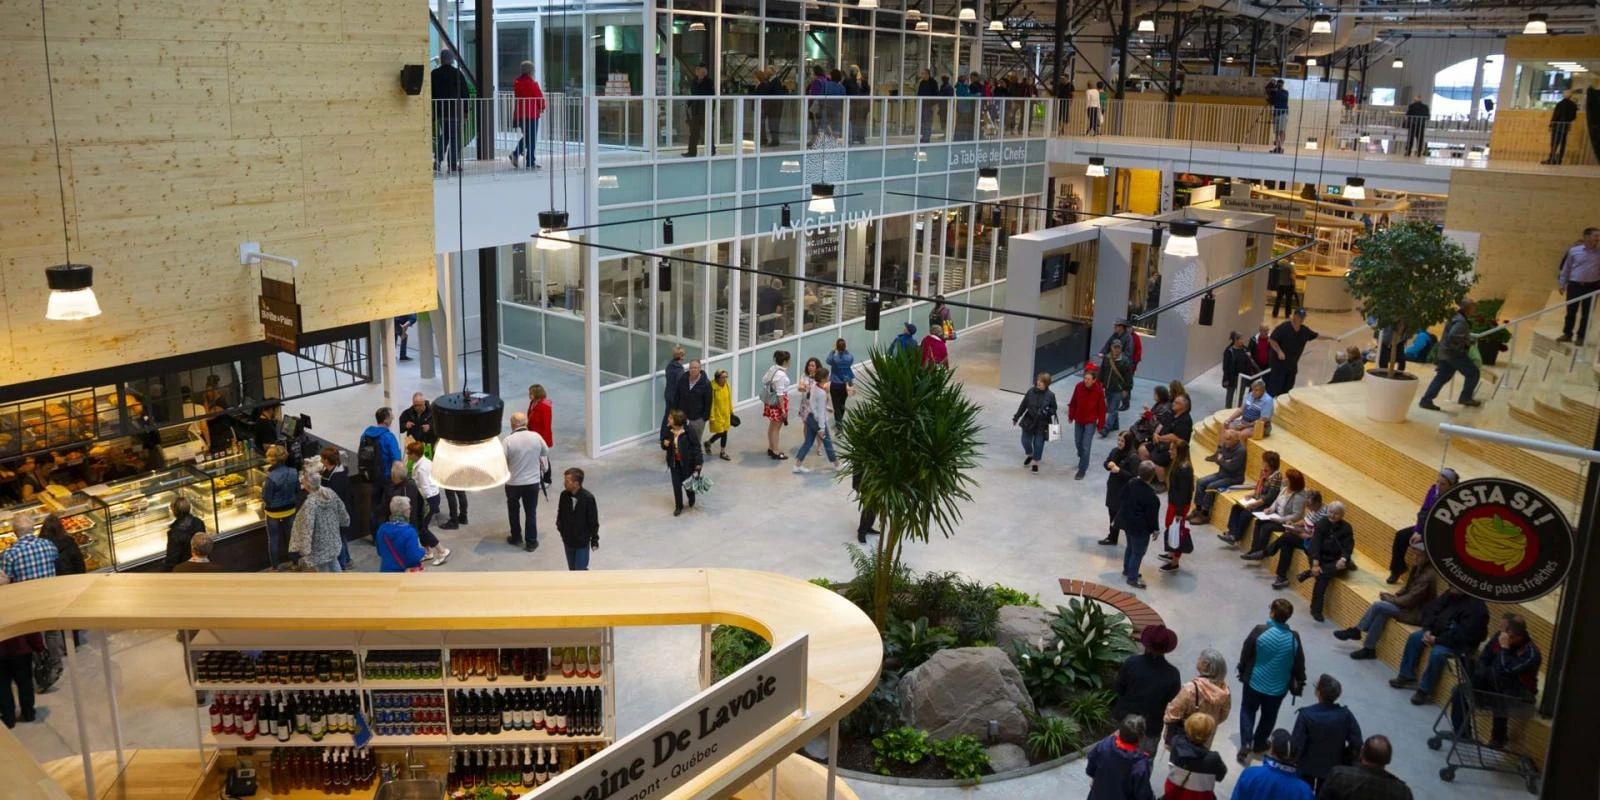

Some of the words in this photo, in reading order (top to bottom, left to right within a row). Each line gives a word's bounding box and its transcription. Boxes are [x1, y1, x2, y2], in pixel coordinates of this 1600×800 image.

[1004, 146, 1025, 160] Chefs
[771, 209, 873, 242] MYCELIUM
[1434, 485, 1506, 525] PASTA
[1441, 557, 1479, 588] Artisans
[1479, 580, 1493, 592] de
[572, 756, 646, 800] aine
[652, 729, 691, 768] De
[698, 675, 777, 741] Lavoie
[629, 778, 661, 800] mont
[671, 742, 718, 780] Québec
